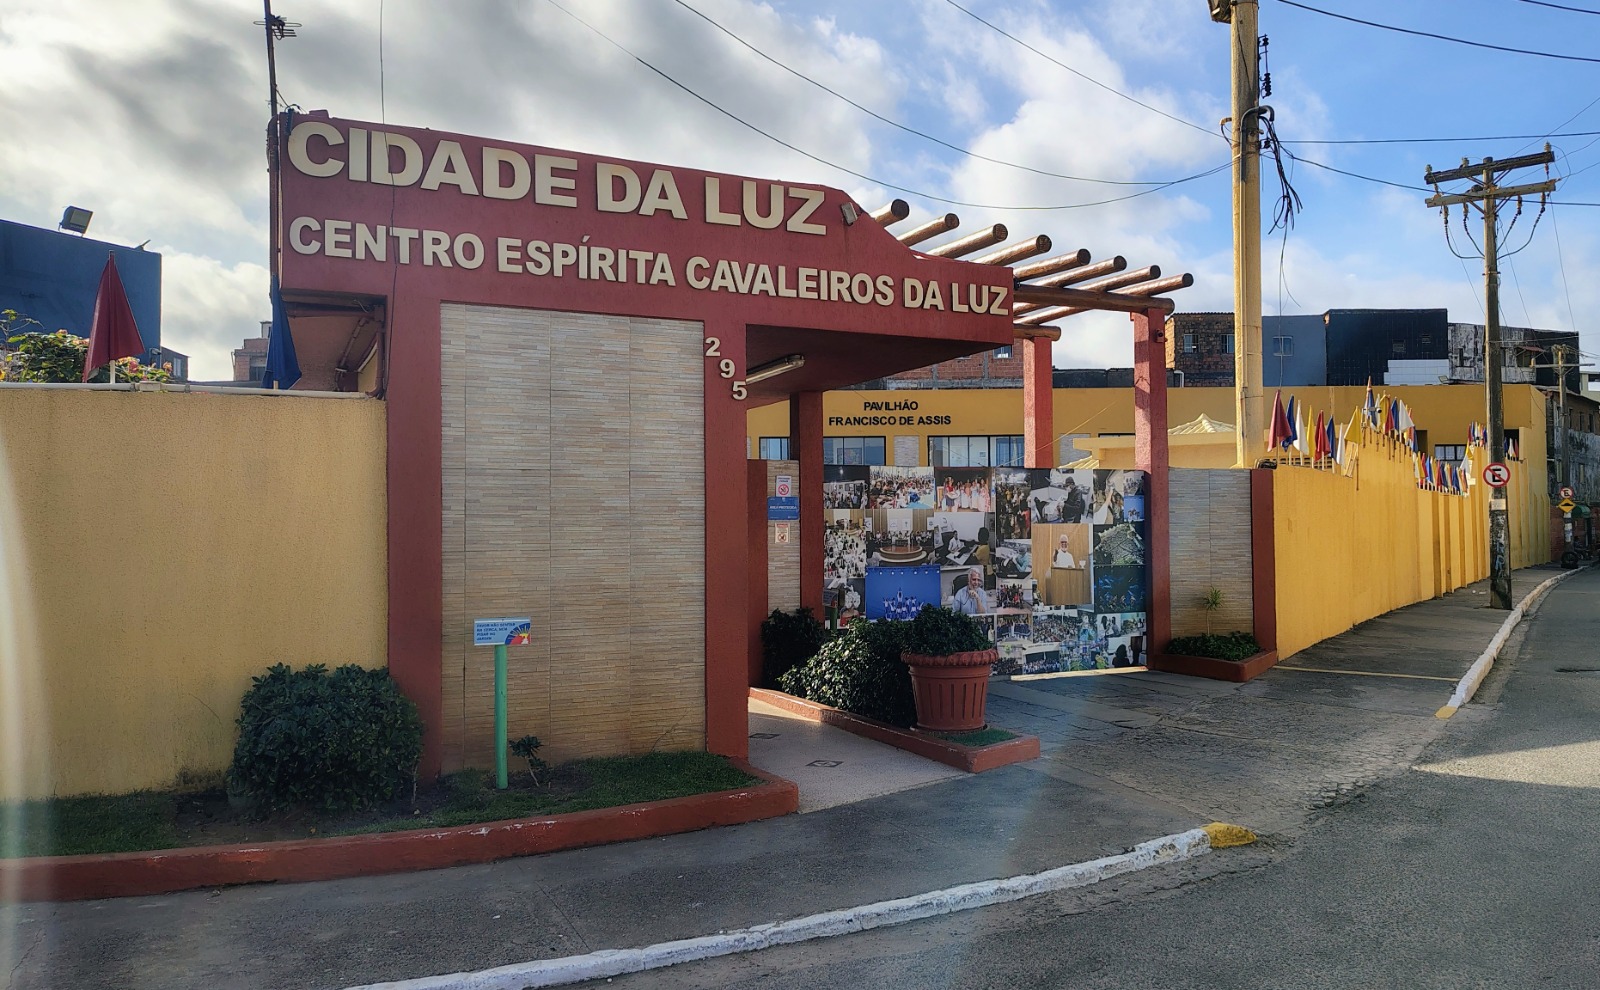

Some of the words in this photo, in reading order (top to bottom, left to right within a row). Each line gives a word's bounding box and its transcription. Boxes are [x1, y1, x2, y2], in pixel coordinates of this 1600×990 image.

[287, 121, 577, 208] CIDADE
[596, 162, 688, 220] DA
[704, 176, 827, 236] LUZ
[289, 215, 486, 270] CENTRO
[497, 235, 676, 287] ESPÍRITA
[685, 256, 895, 307] CAVALEIROS
[903, 277, 945, 311] DA
[951, 282, 1009, 316] LUZ
[828, 416, 897, 426] FRANCISCO
[899, 416, 914, 426] DE
[917, 415, 952, 425] ASSIS
[863, 399, 919, 411] PAVILHÃO
